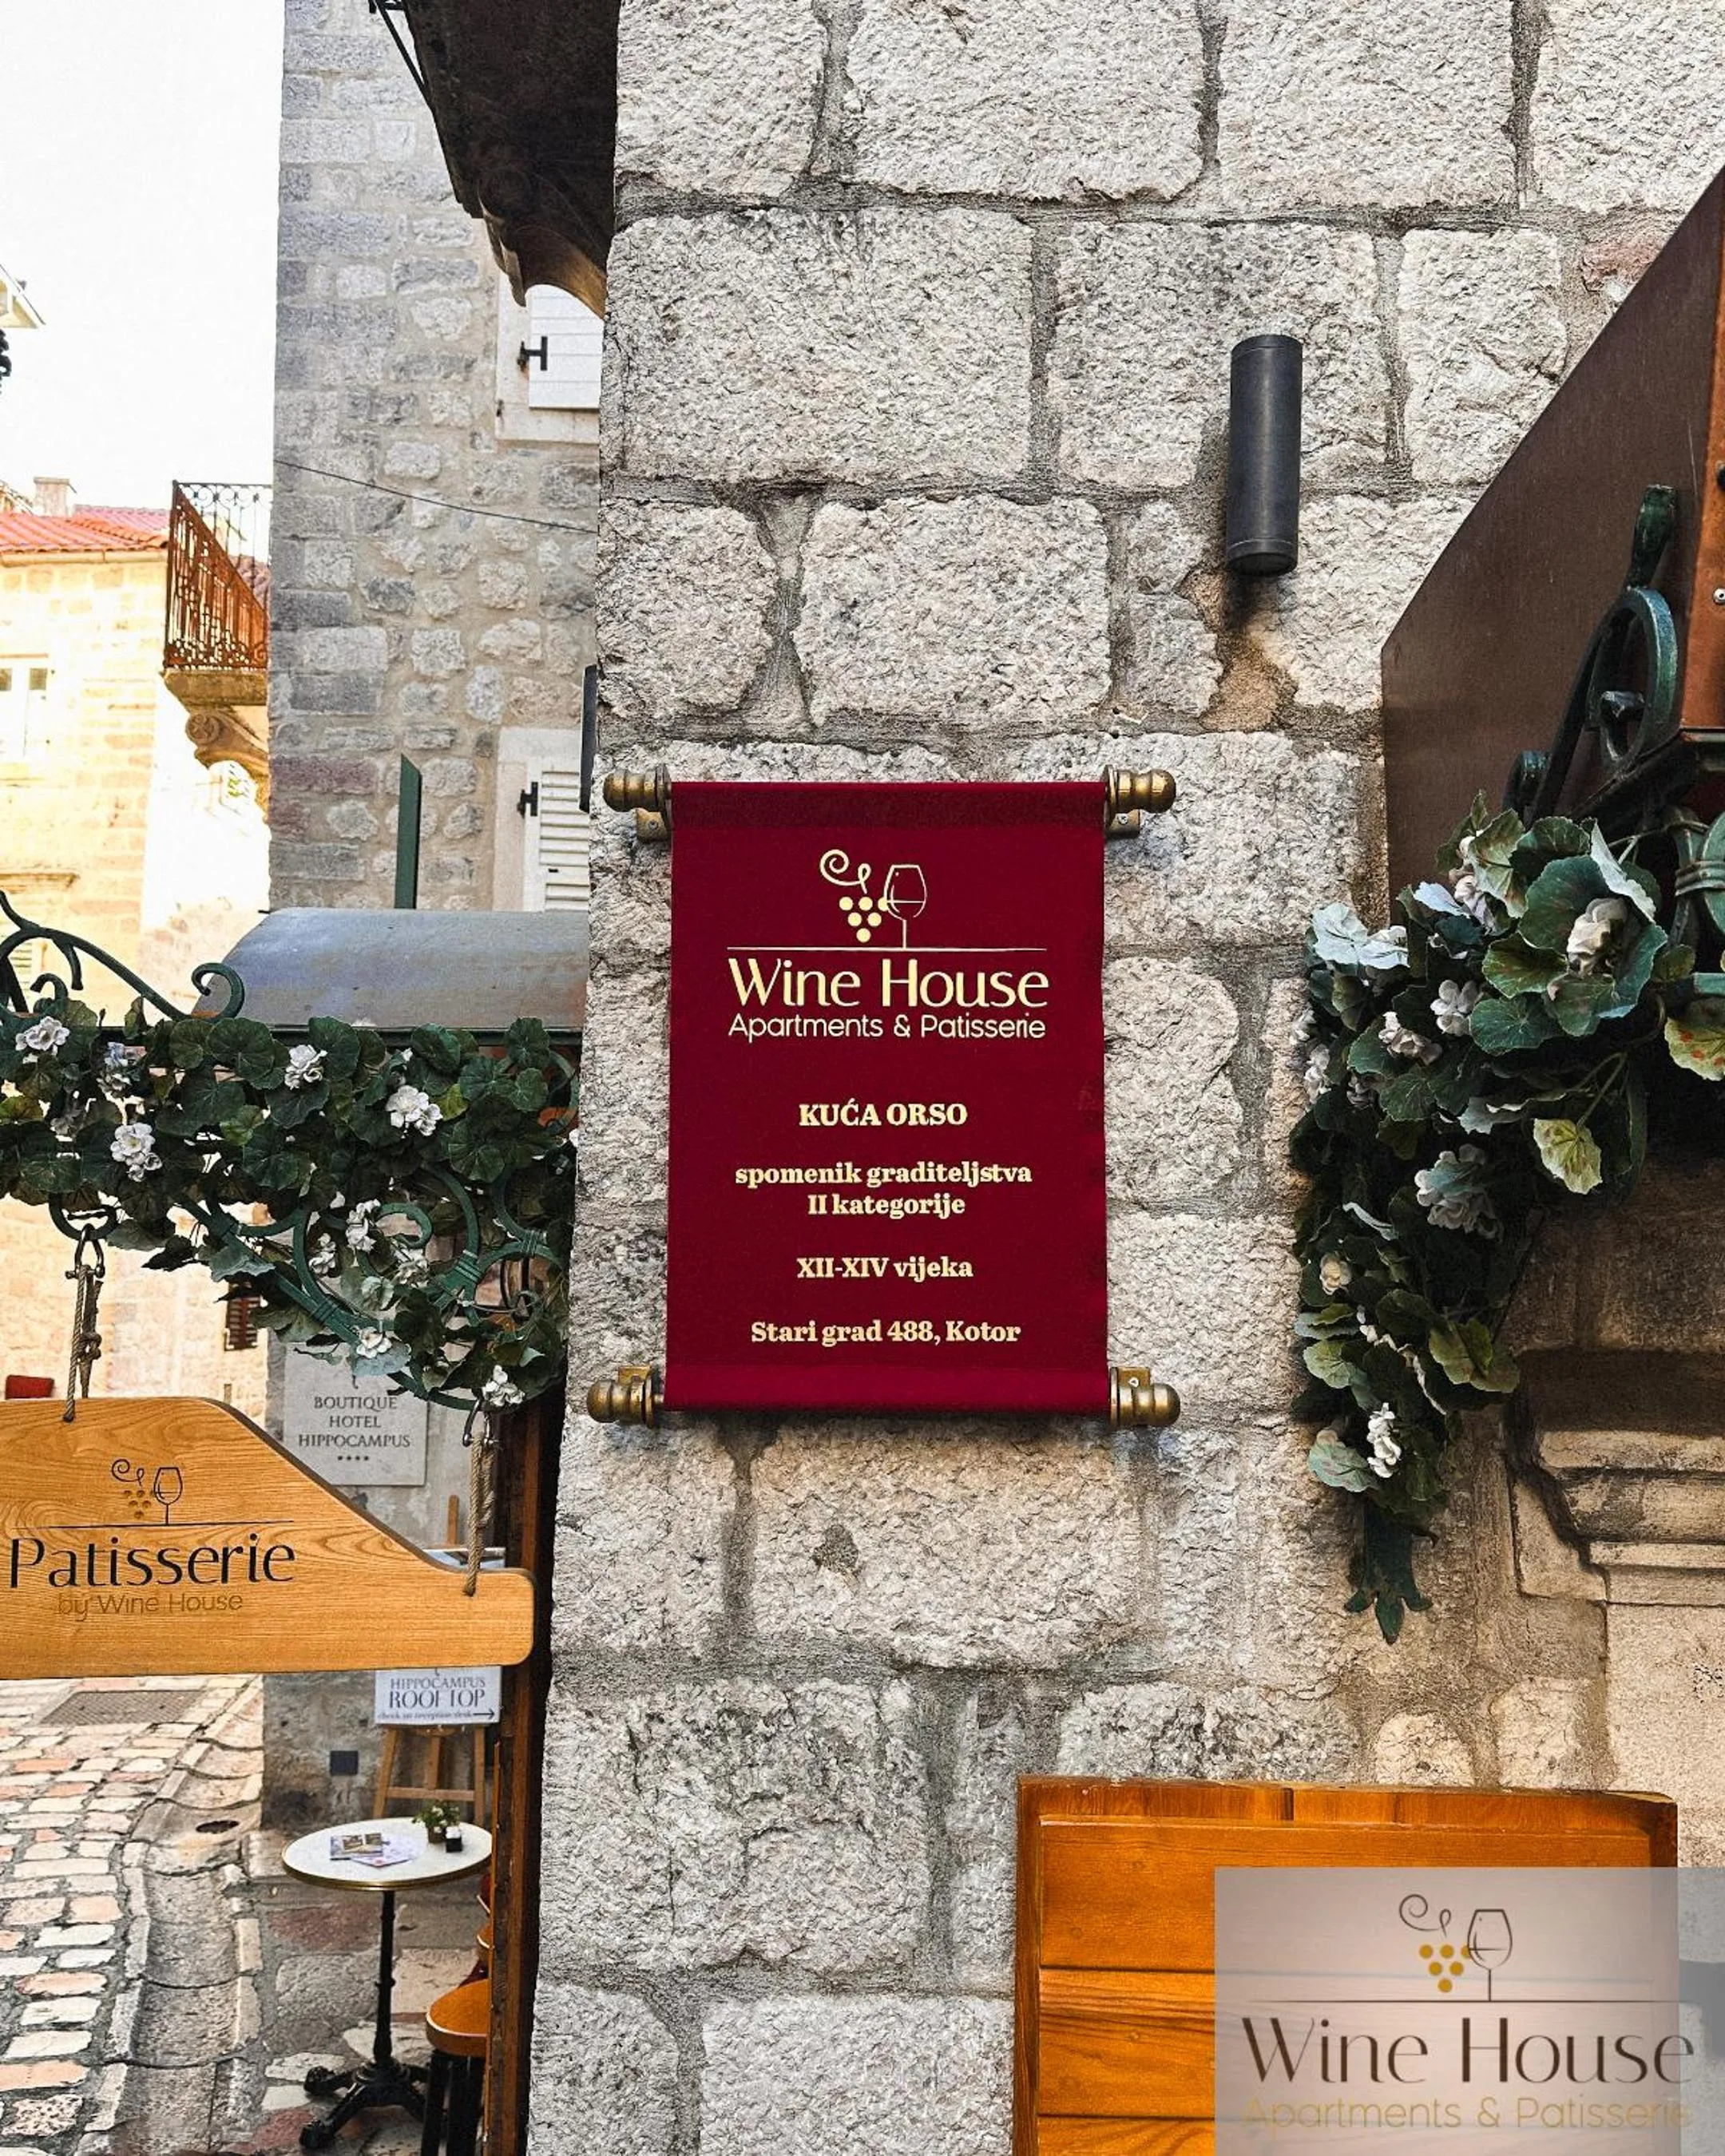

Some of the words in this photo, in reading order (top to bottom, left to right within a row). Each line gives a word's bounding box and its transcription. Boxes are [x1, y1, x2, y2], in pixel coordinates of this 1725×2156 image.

[728, 958, 861, 1007] Wine
[882, 958, 1049, 1008] House
[728, 1013, 884, 1043] Apartments
[894, 1014, 911, 1037] &
[921, 1012, 1046, 1039] Patisserie
[799, 1098, 882, 1127] KUĆA
[886, 1103, 969, 1126] ORSO
[736, 1162, 862, 1188] spomenik
[866, 1161, 1033, 1187] graditeljstva
[808, 1195, 827, 1215] II
[831, 1192, 966, 1219] kategorije
[797, 1257, 889, 1278] XII-XIV
[893, 1256, 974, 1282] vijeka
[751, 1320, 818, 1342] Stari
[822, 1320, 882, 1348] grad
[886, 1321, 941, 1346] 488,
[946, 1321, 1021, 1342] Kotor
[314, 1397, 398, 1412] BOUTIQUE
[329, 1415, 382, 1429] HOTEL
[299, 1434, 411, 1448] HIPPOCAMPUS
[10, 1532, 295, 1589] Patisserie
[58, 1592, 87, 1623] by
[96, 1595, 159, 1615] Wine
[169, 1593, 244, 1613] House
[391, 1677, 486, 1690] HIPPOCAMPUS
